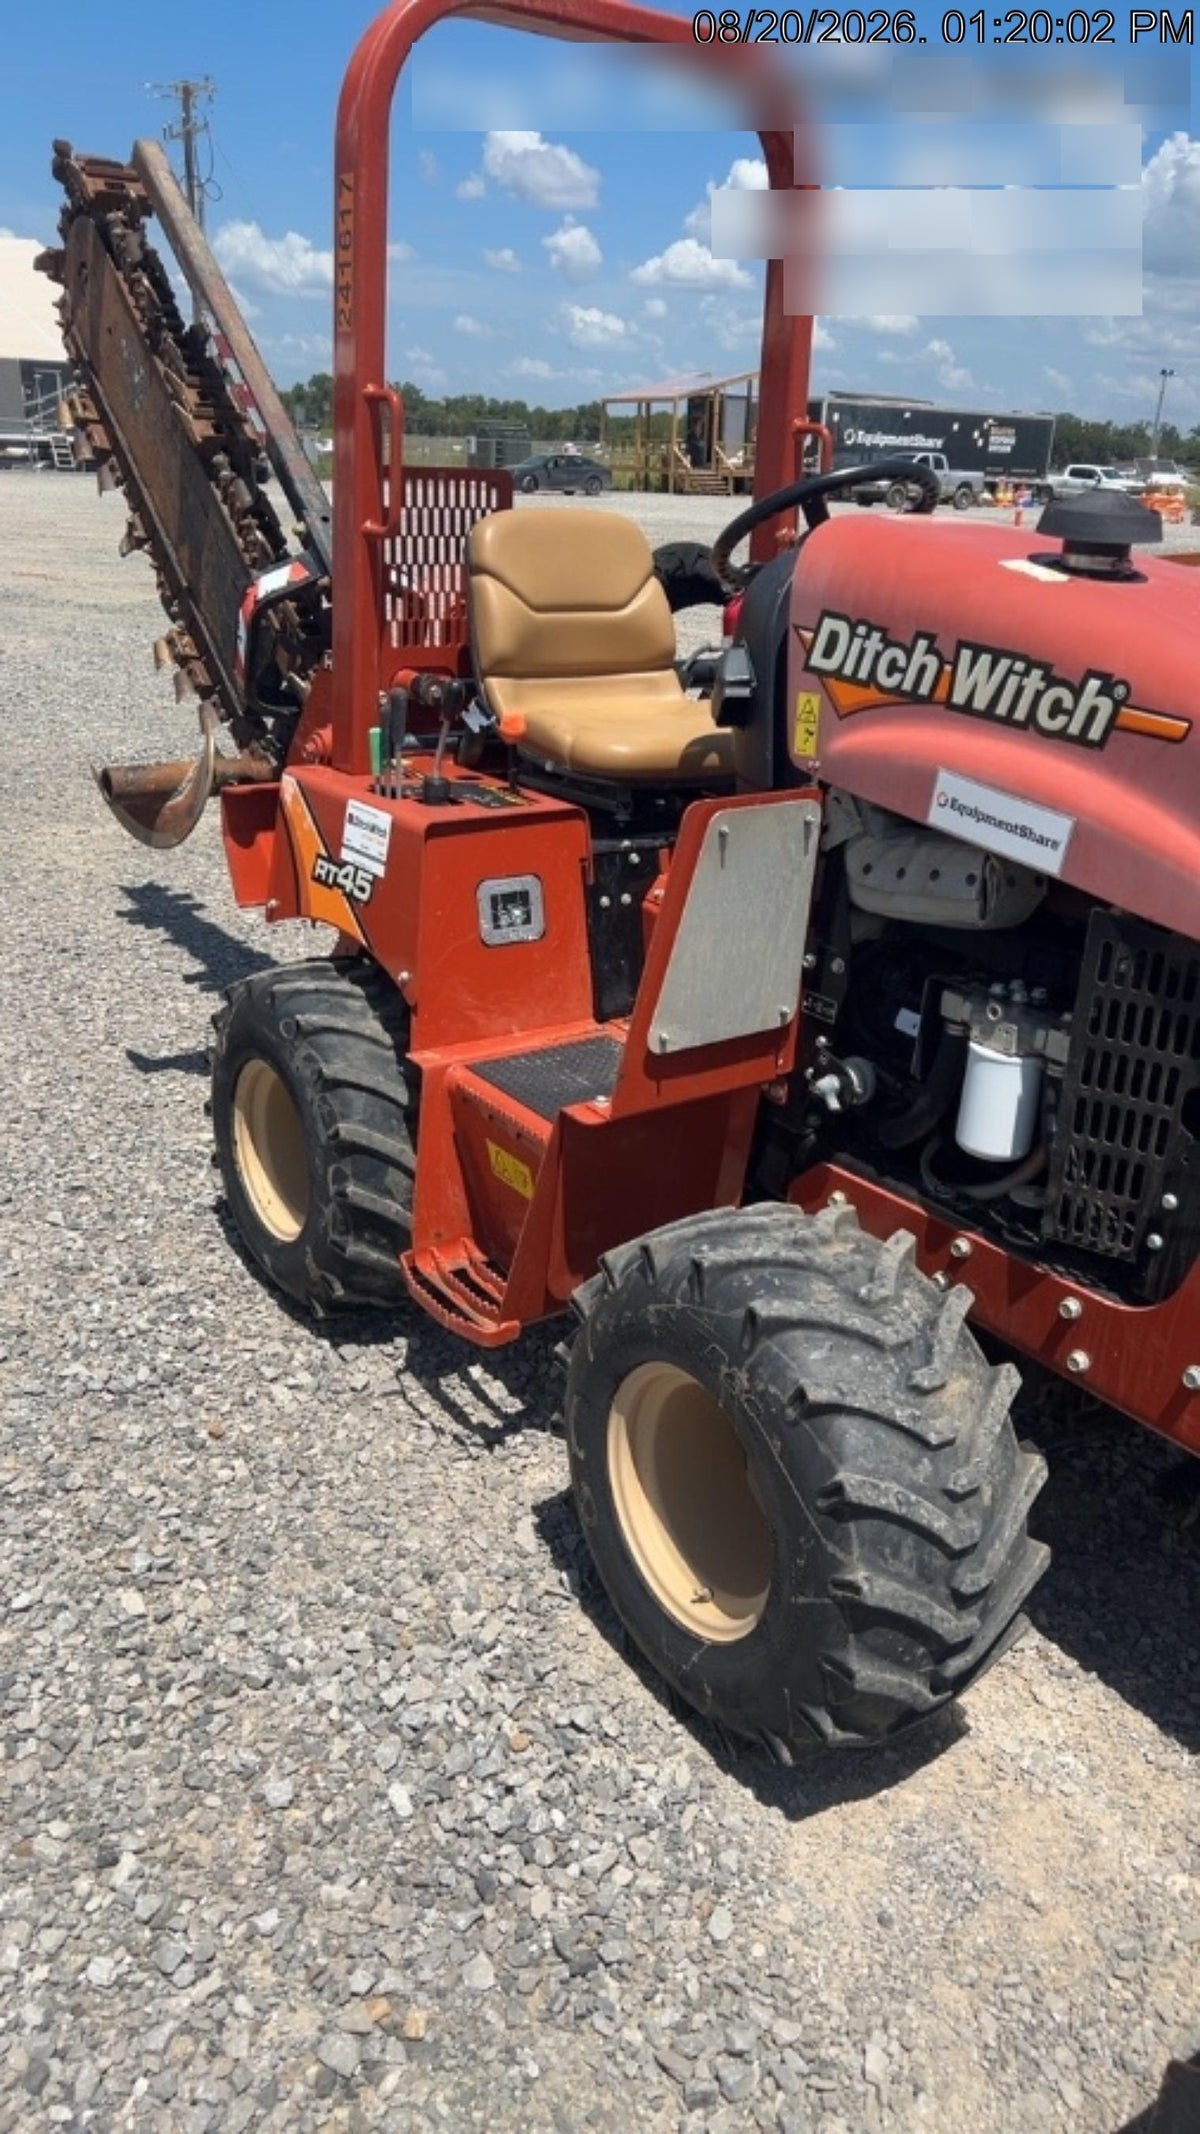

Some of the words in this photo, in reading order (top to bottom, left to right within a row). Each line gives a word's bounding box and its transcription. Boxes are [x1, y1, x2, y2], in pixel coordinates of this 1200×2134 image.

[338, 175, 352, 327] 241617
[808, 613, 942, 697] Ditch
[949, 798, 1061, 853] EquipmentShare
[315, 858, 374, 902] RT45
